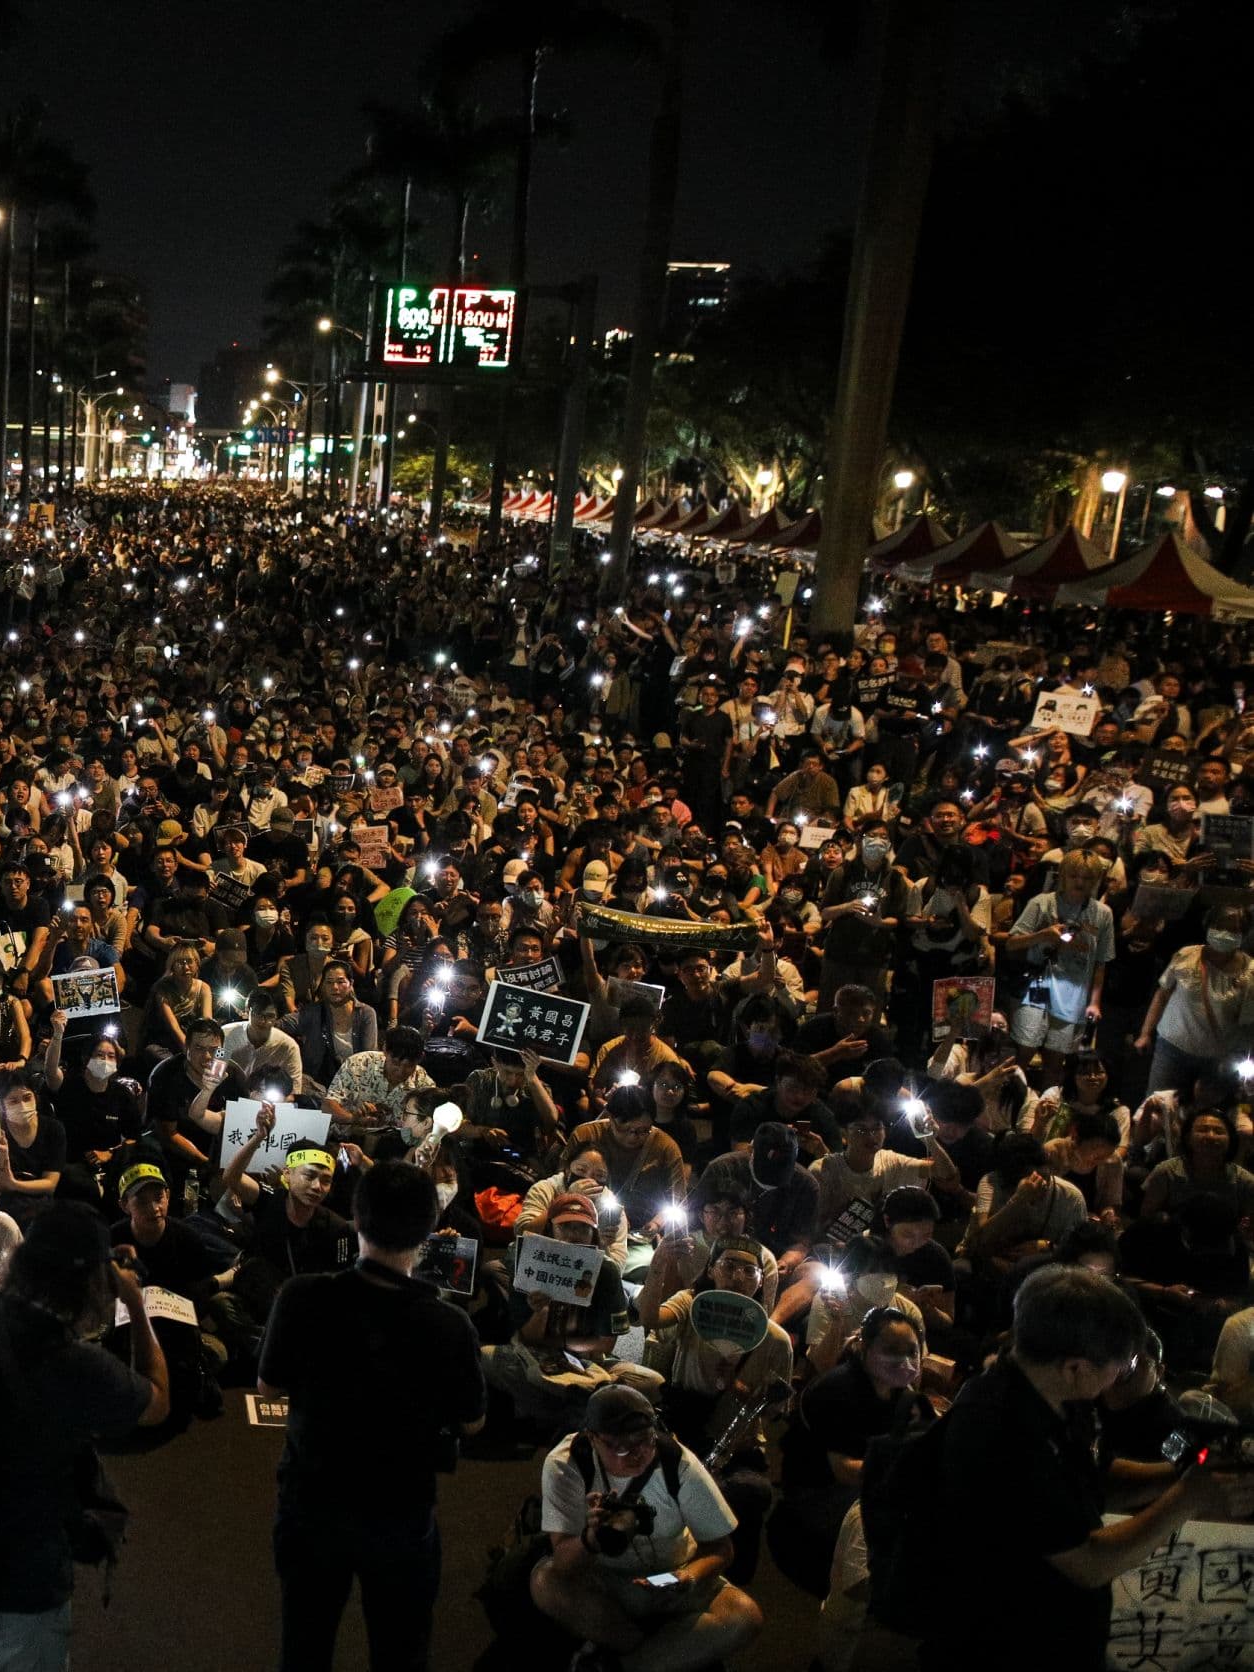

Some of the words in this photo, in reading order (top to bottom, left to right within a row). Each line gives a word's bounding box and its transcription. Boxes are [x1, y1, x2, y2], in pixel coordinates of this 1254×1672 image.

[505, 965, 553, 983] 沒有討論
[529, 1005, 573, 1028] 黃國昌
[523, 1024, 569, 1046] 偽君子
